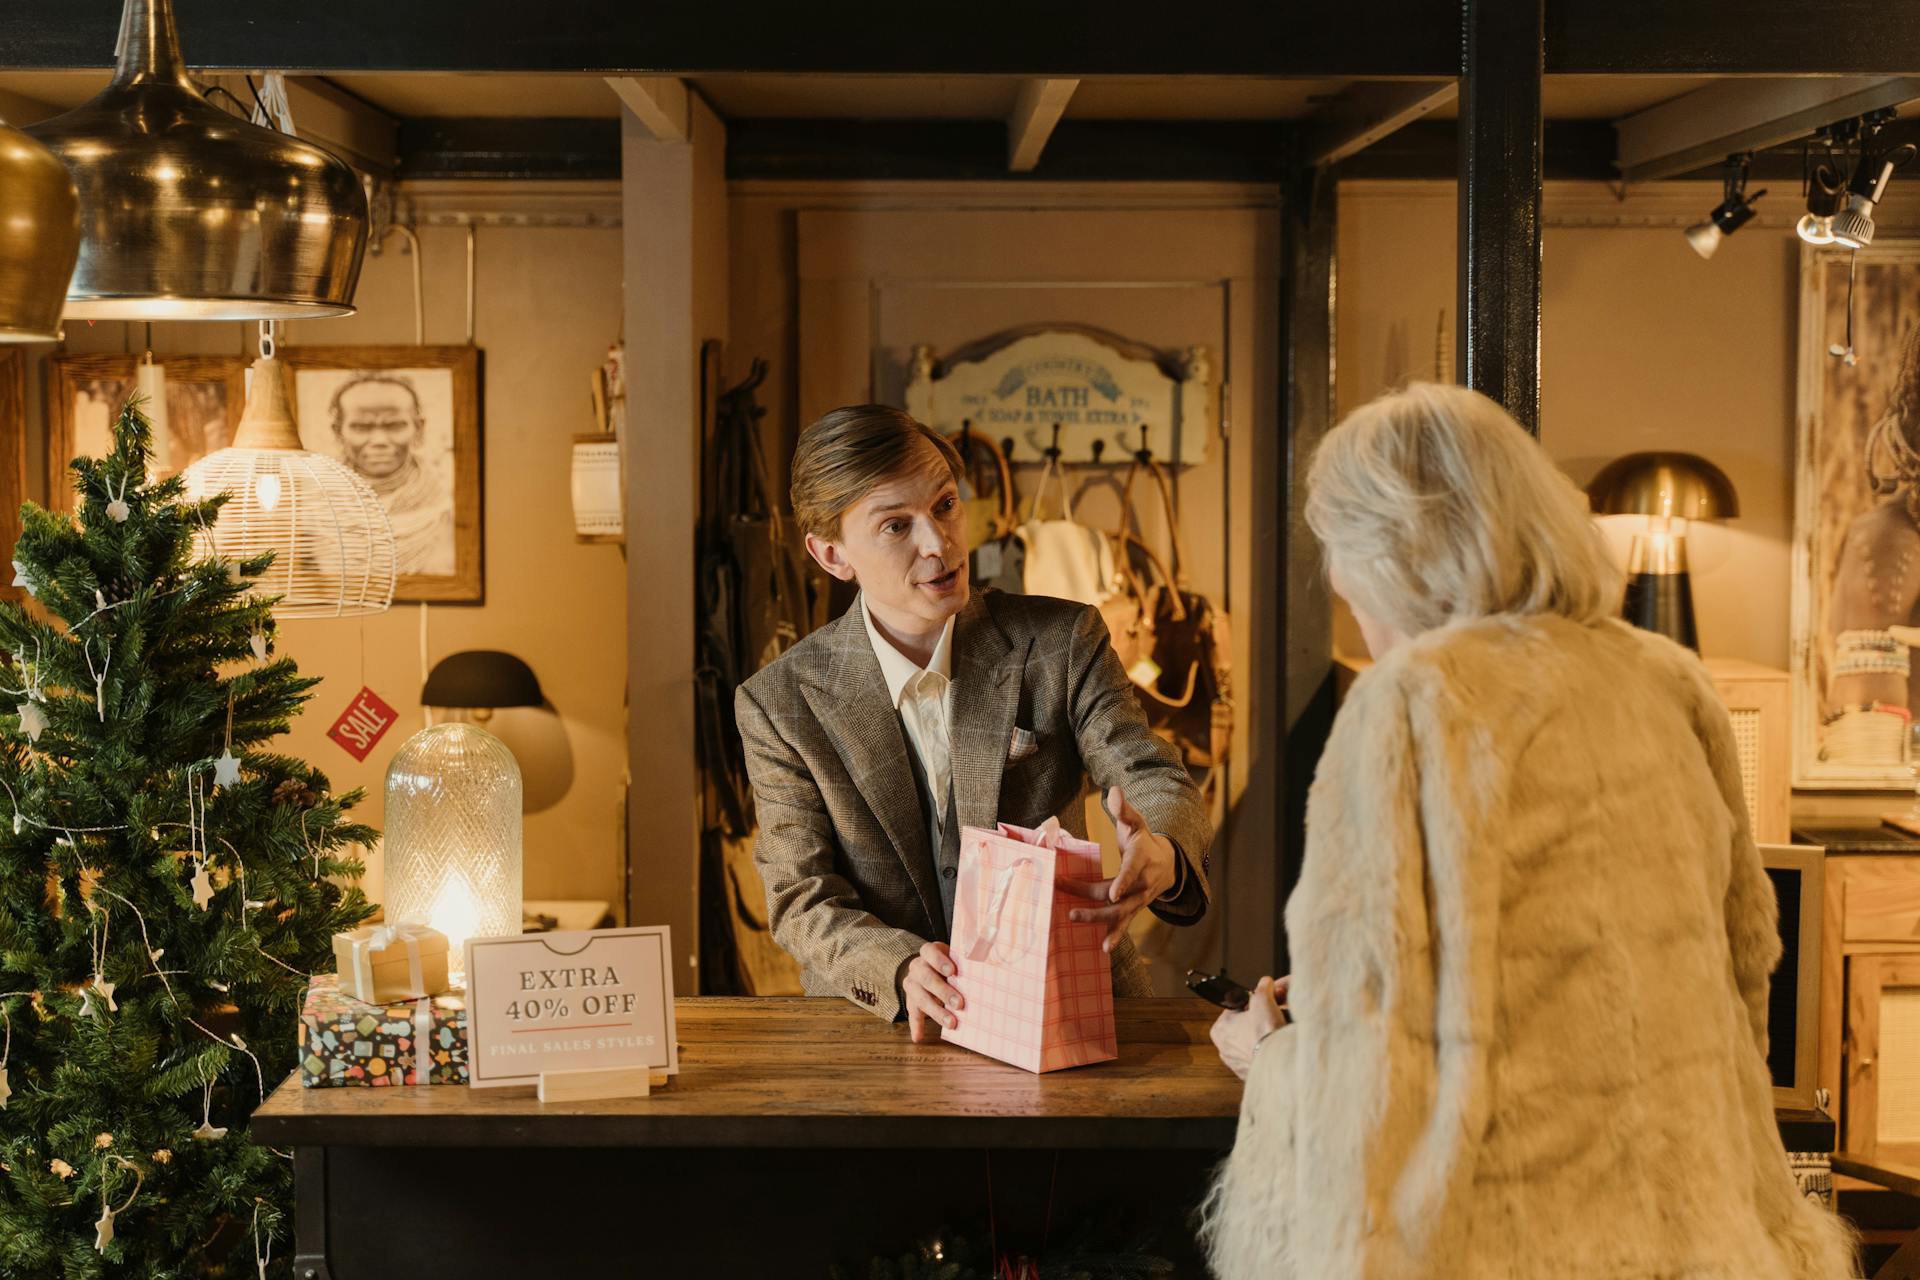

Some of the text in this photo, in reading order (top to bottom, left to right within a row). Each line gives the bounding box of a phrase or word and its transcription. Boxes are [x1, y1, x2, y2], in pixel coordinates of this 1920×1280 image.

[1026, 386, 1089, 407] BATH
[1087, 410, 1128, 423] EXTRA
[339, 699, 388, 750] SALE
[520, 966, 621, 991] EXTRA
[505, 993, 637, 1021] 40% OFF
[489, 1035, 655, 1057] FINAL SALES STYLES
